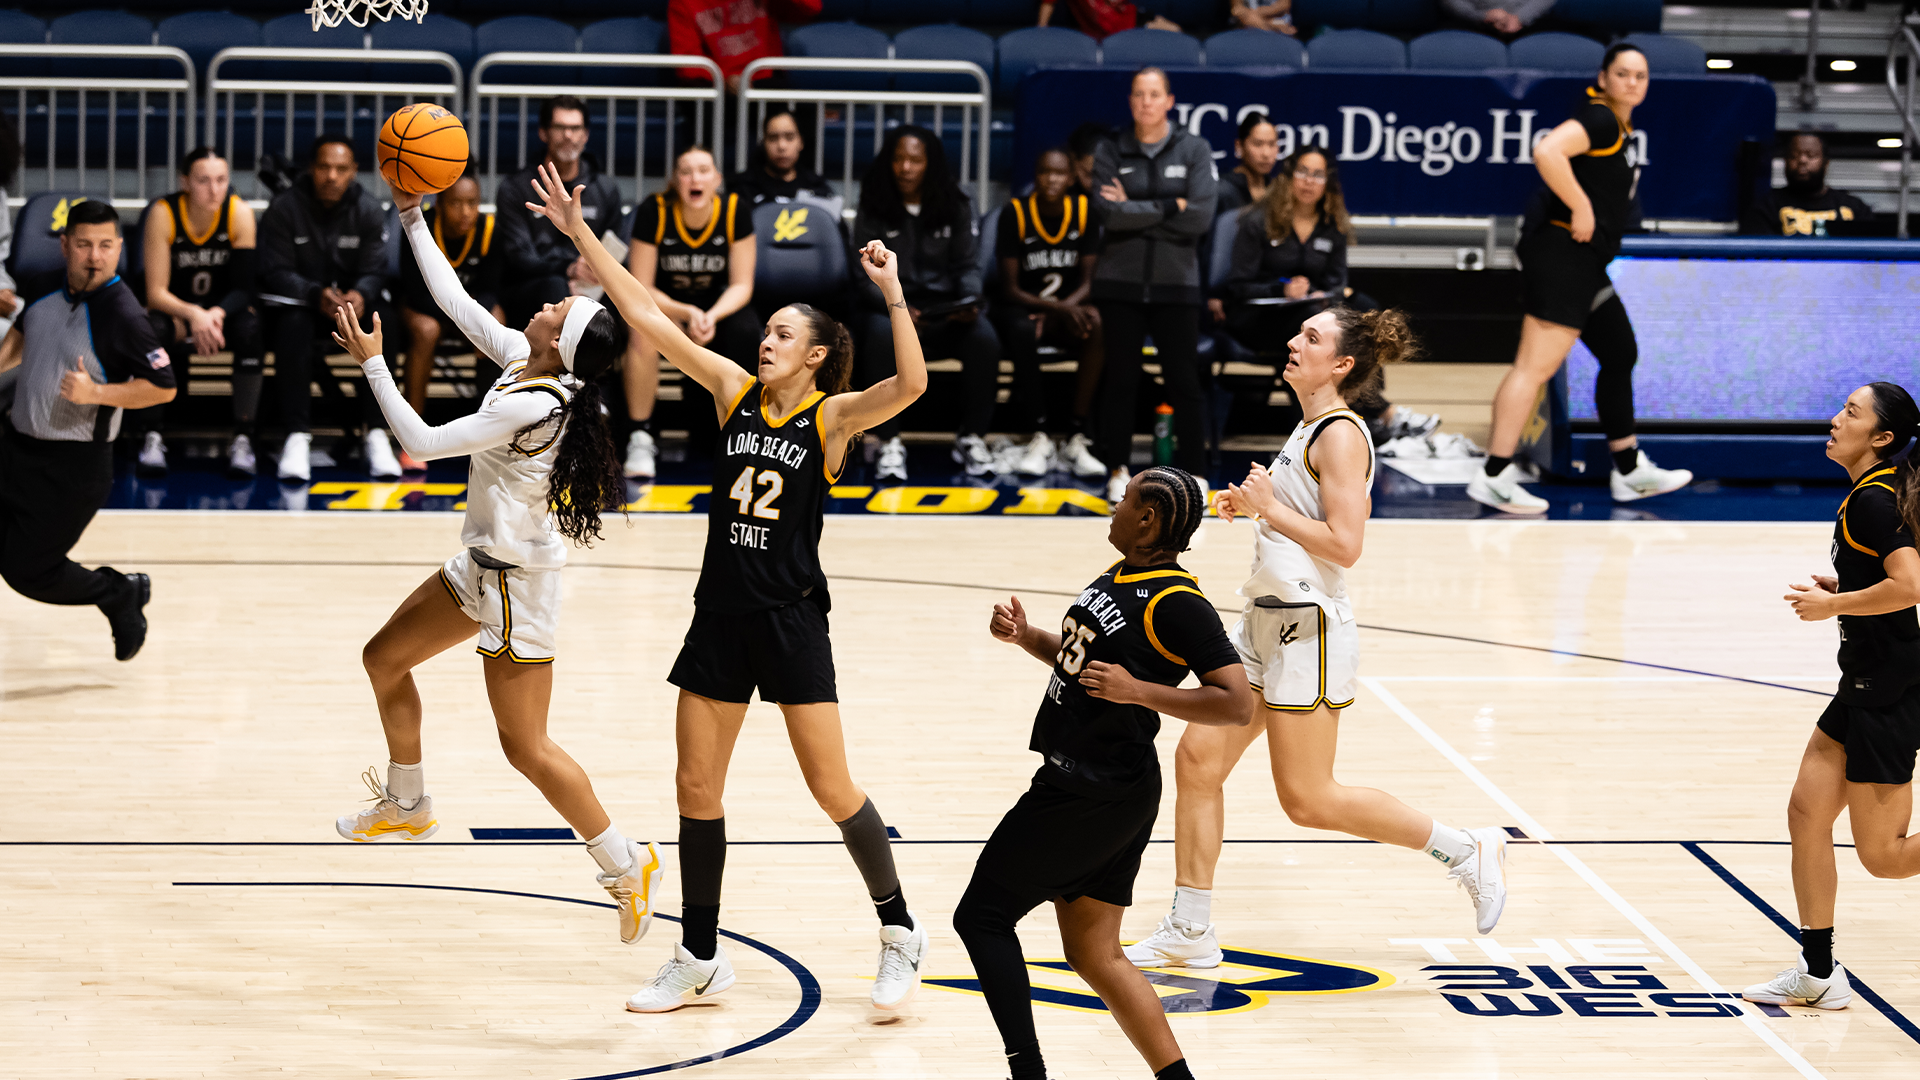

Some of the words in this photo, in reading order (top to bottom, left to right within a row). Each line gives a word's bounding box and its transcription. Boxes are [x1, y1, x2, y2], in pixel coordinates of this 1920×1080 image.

[1236, 103, 1331, 161] an
[1337, 104, 1482, 177] Diego
[1041, 272, 1062, 302] 2
[727, 431, 760, 456] LONG
[761, 436, 808, 470] BEACH
[729, 465, 784, 520] 42
[729, 521, 770, 550] STATE
[1072, 587, 1099, 607] NG
[1087, 591, 1127, 637] BEACH
[1056, 616, 1097, 676] 25
[1388, 938, 1664, 963] THE
[1419, 965, 1669, 990] BIG
